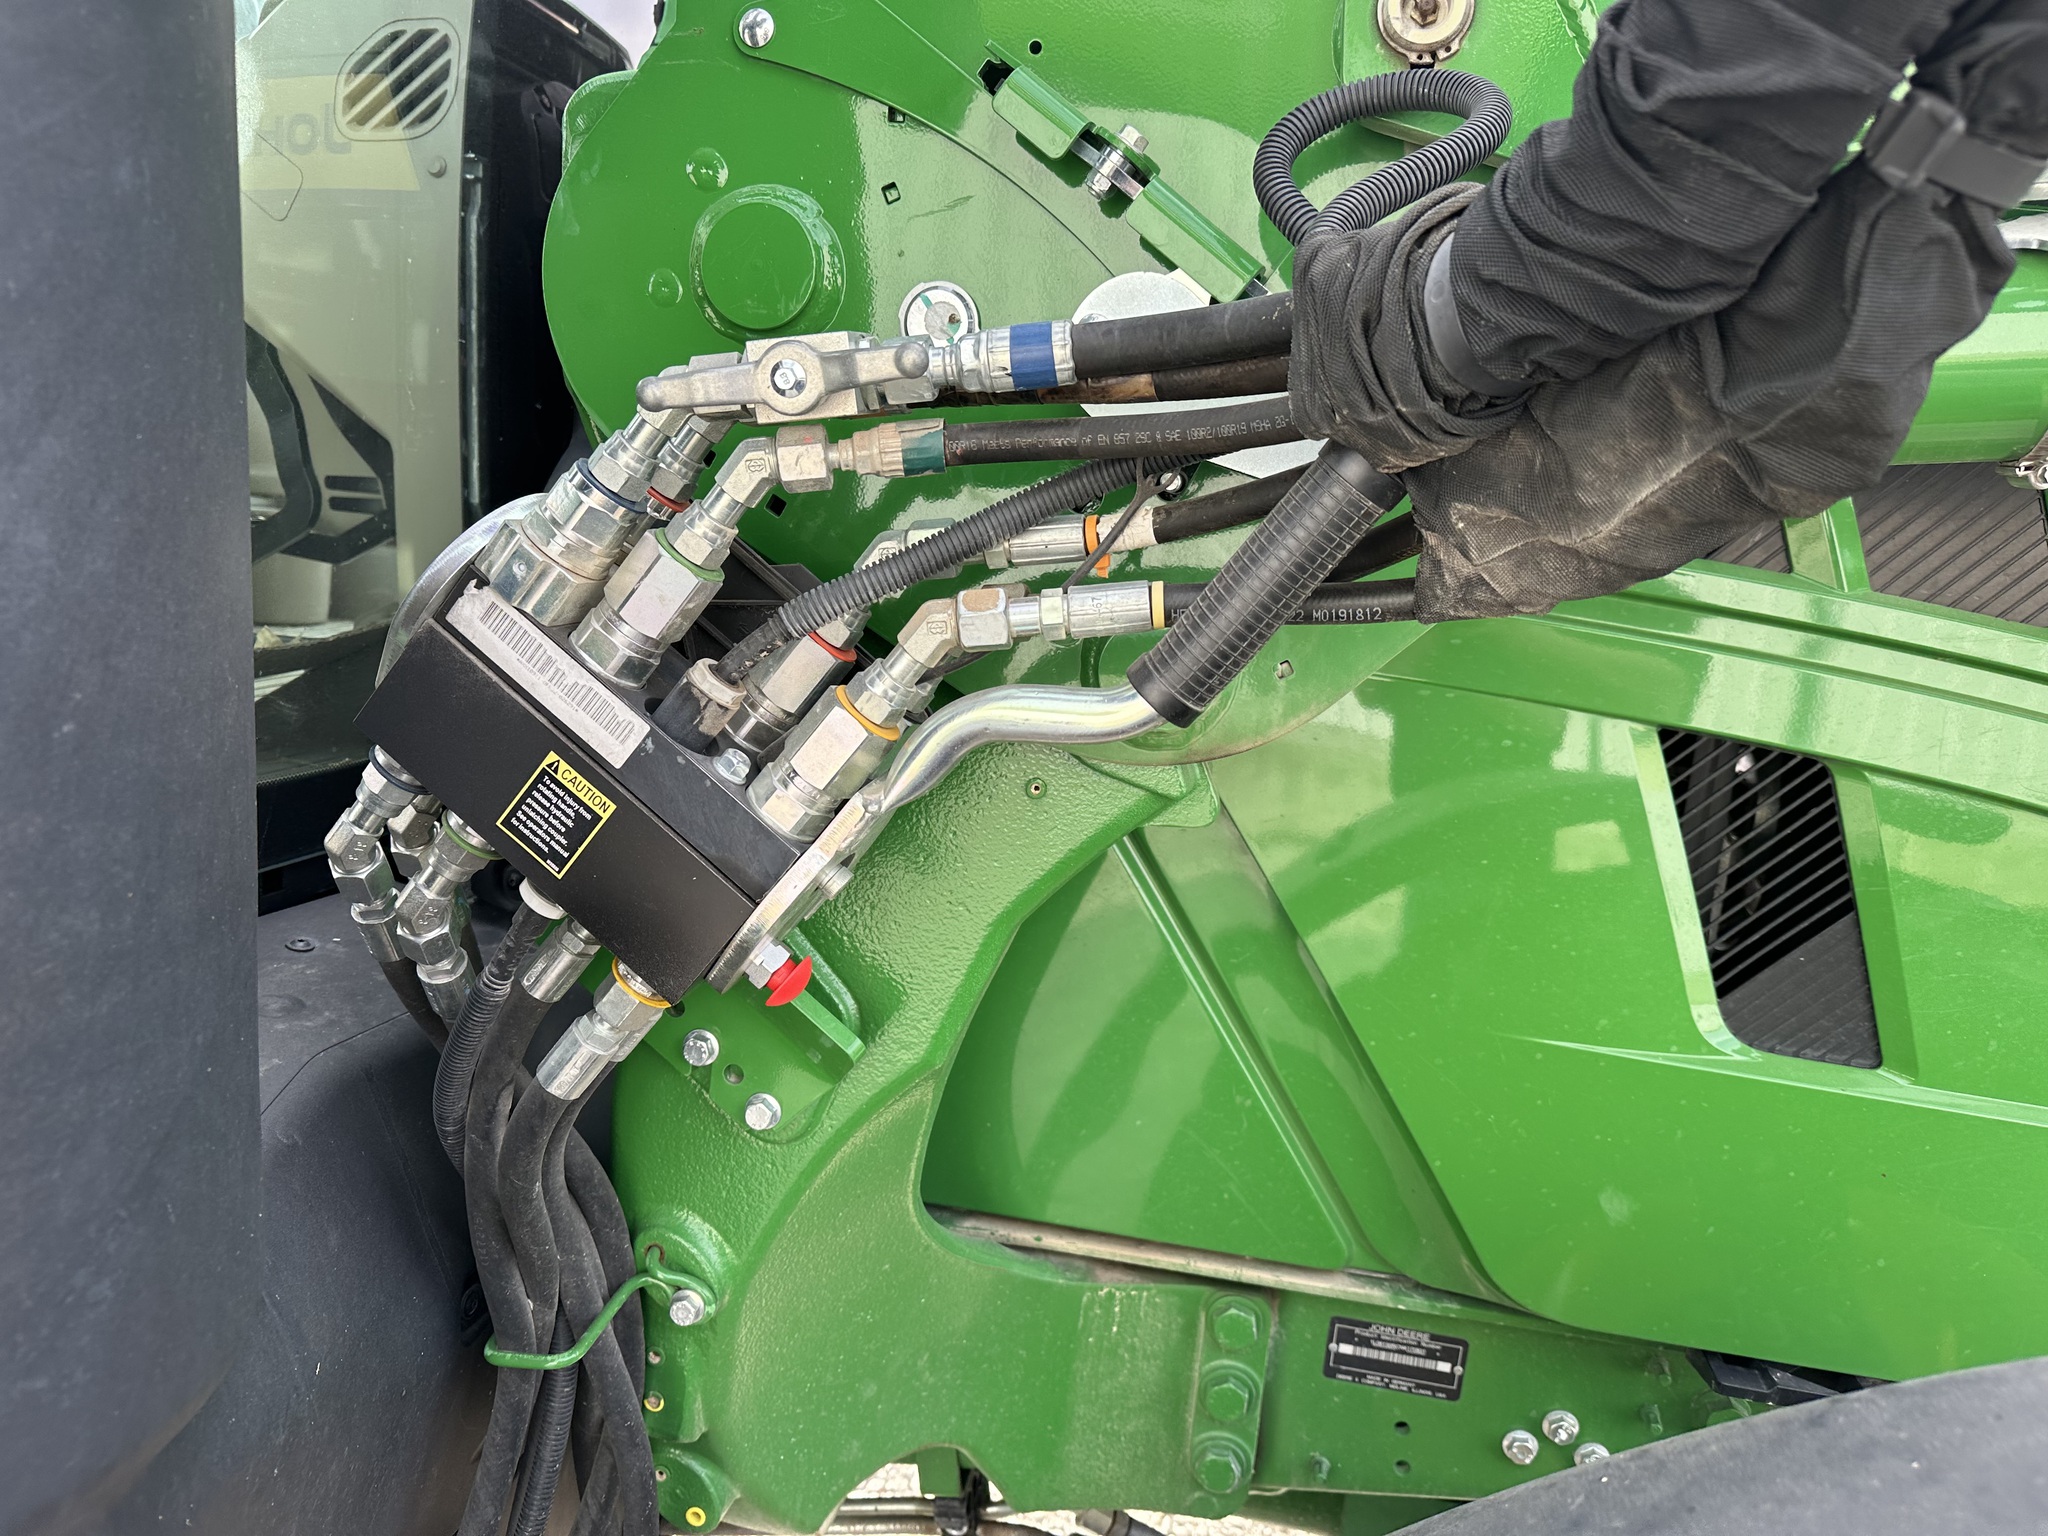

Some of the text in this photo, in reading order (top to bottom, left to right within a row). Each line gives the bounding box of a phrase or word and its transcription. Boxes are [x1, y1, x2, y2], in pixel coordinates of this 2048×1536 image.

[1097, 434, 1110, 445] EN
[1166, 430, 1182, 442] SAE
[537, 784, 558, 803] rotating
[543, 776, 591, 820] To avoid injury from
[562, 770, 610, 813] CAUTION
[511, 817, 520, 826] for
[521, 804, 548, 830] unlatching
[526, 798, 565, 832] pressure before
[532, 790, 574, 828] release hydraulic
[516, 810, 527, 821] See
[550, 840, 569, 858] manual
[1369, 1325, 1430, 1340] JOHN DEERE
